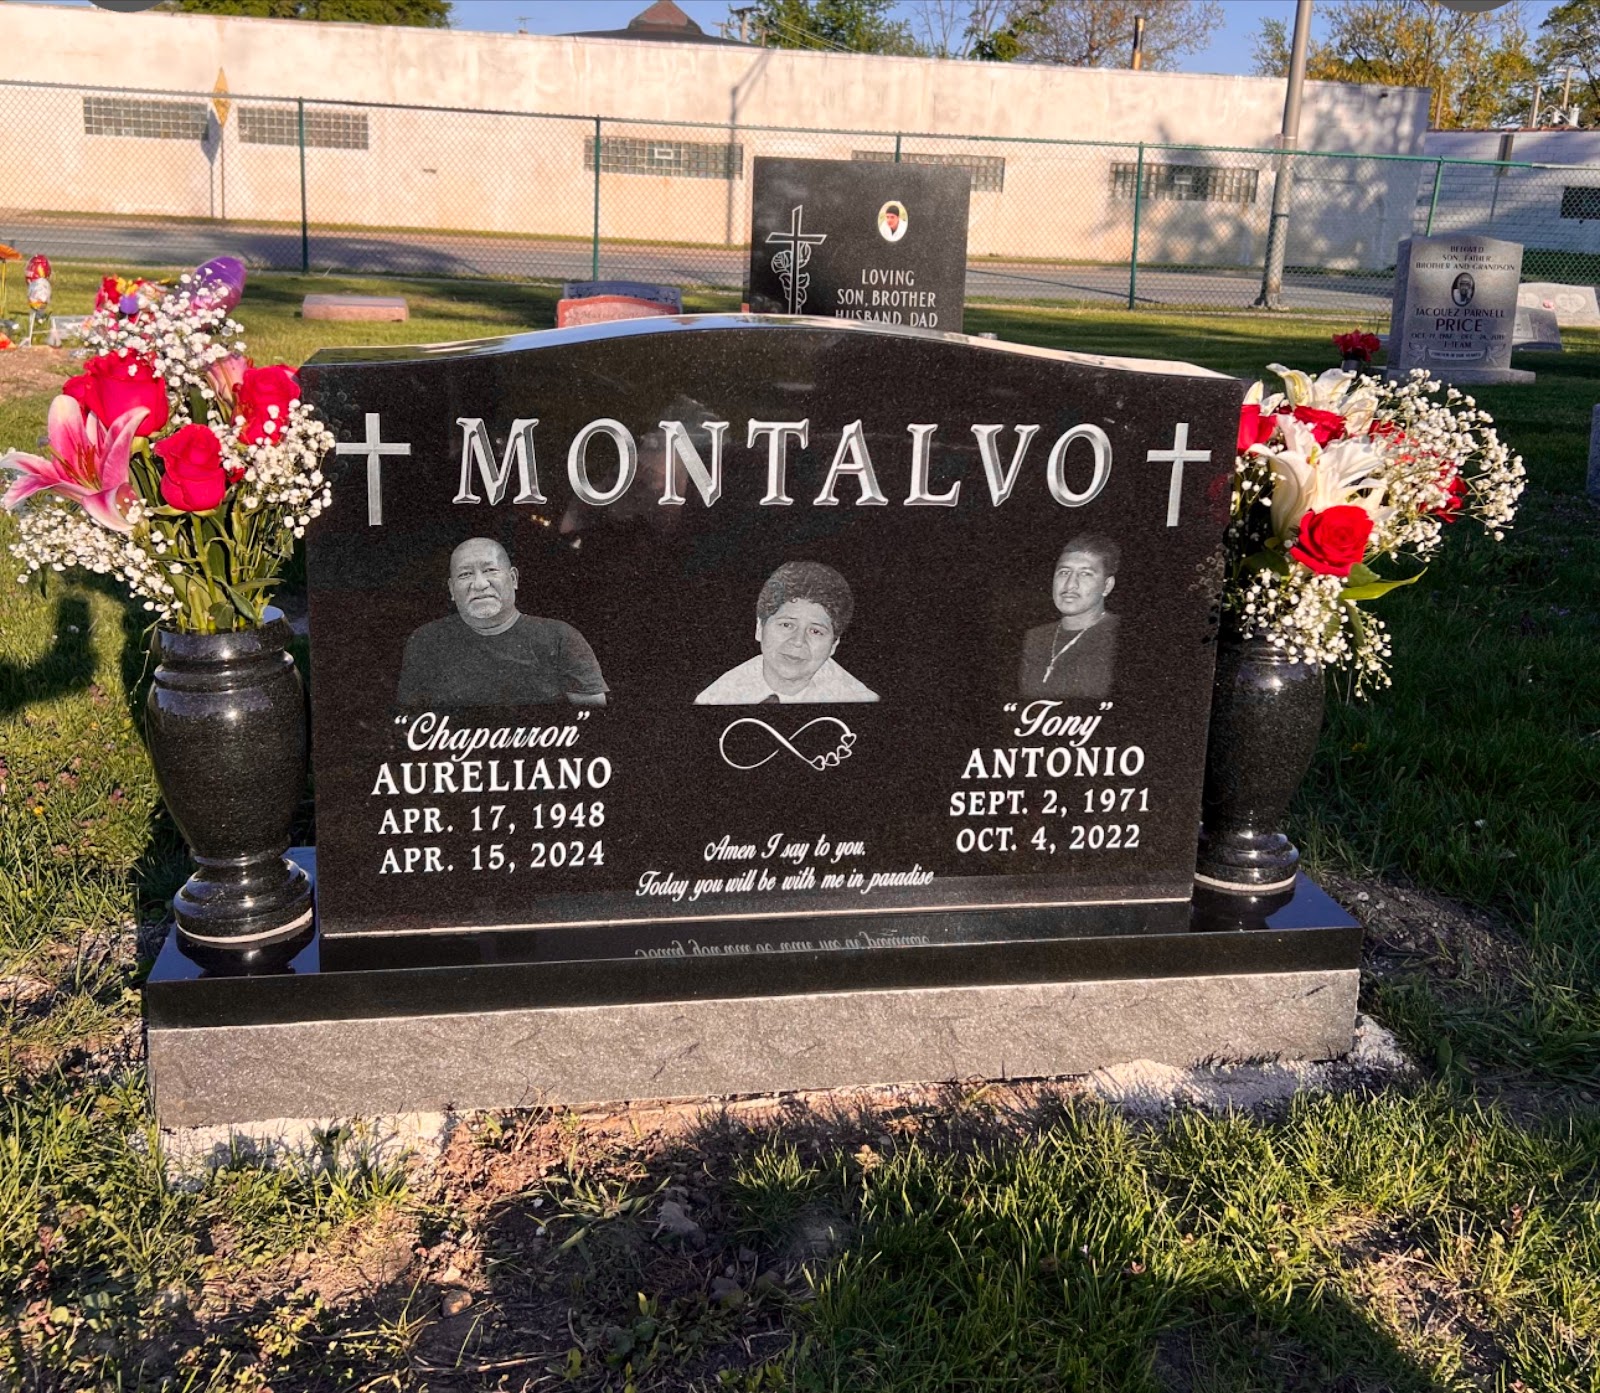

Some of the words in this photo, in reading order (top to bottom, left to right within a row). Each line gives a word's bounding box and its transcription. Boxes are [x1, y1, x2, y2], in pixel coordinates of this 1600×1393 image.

[862, 268, 914, 286] LOVING
[836, 288, 868, 307] SON,
[872, 290, 936, 308] BROTHER
[1464, 308, 1504, 318] PARNELL
[910, 312, 938, 328] DAD
[1436, 319, 1483, 332] PRICE
[452, 416, 1114, 508] MONTALVO
[1004, 700, 1114, 748] “Tony”
[370, 754, 612, 796] AURELIANO
[960, 744, 1144, 778] ANTONIO
[378, 808, 454, 834] APR.
[472, 804, 516, 834] 17,
[532, 800, 604, 830] 1948
[950, 790, 1028, 816] SEPT.
[1042, 790, 1068, 818] 2,
[1084, 788, 1148, 812] 1971
[704, 834, 756, 862] Amen
[760, 832, 784, 858] I
[780, 842, 810, 864] say
[814, 834, 830, 856] to
[956, 826, 1016, 852] OCT.
[1030, 826, 1056, 854] 4,
[1068, 824, 1140, 850] 2022
[378, 846, 454, 874] APR.
[472, 844, 516, 874] 15,
[530, 840, 604, 868] 2024
[636, 870, 690, 902] Today
[686, 878, 724, 902] you
[724, 870, 756, 892] will
[758, 868, 776, 890] be
[782, 866, 816, 890] with
[820, 874, 844, 888] me
[846, 868, 864, 888] in
[860, 864, 934, 894] paradise
